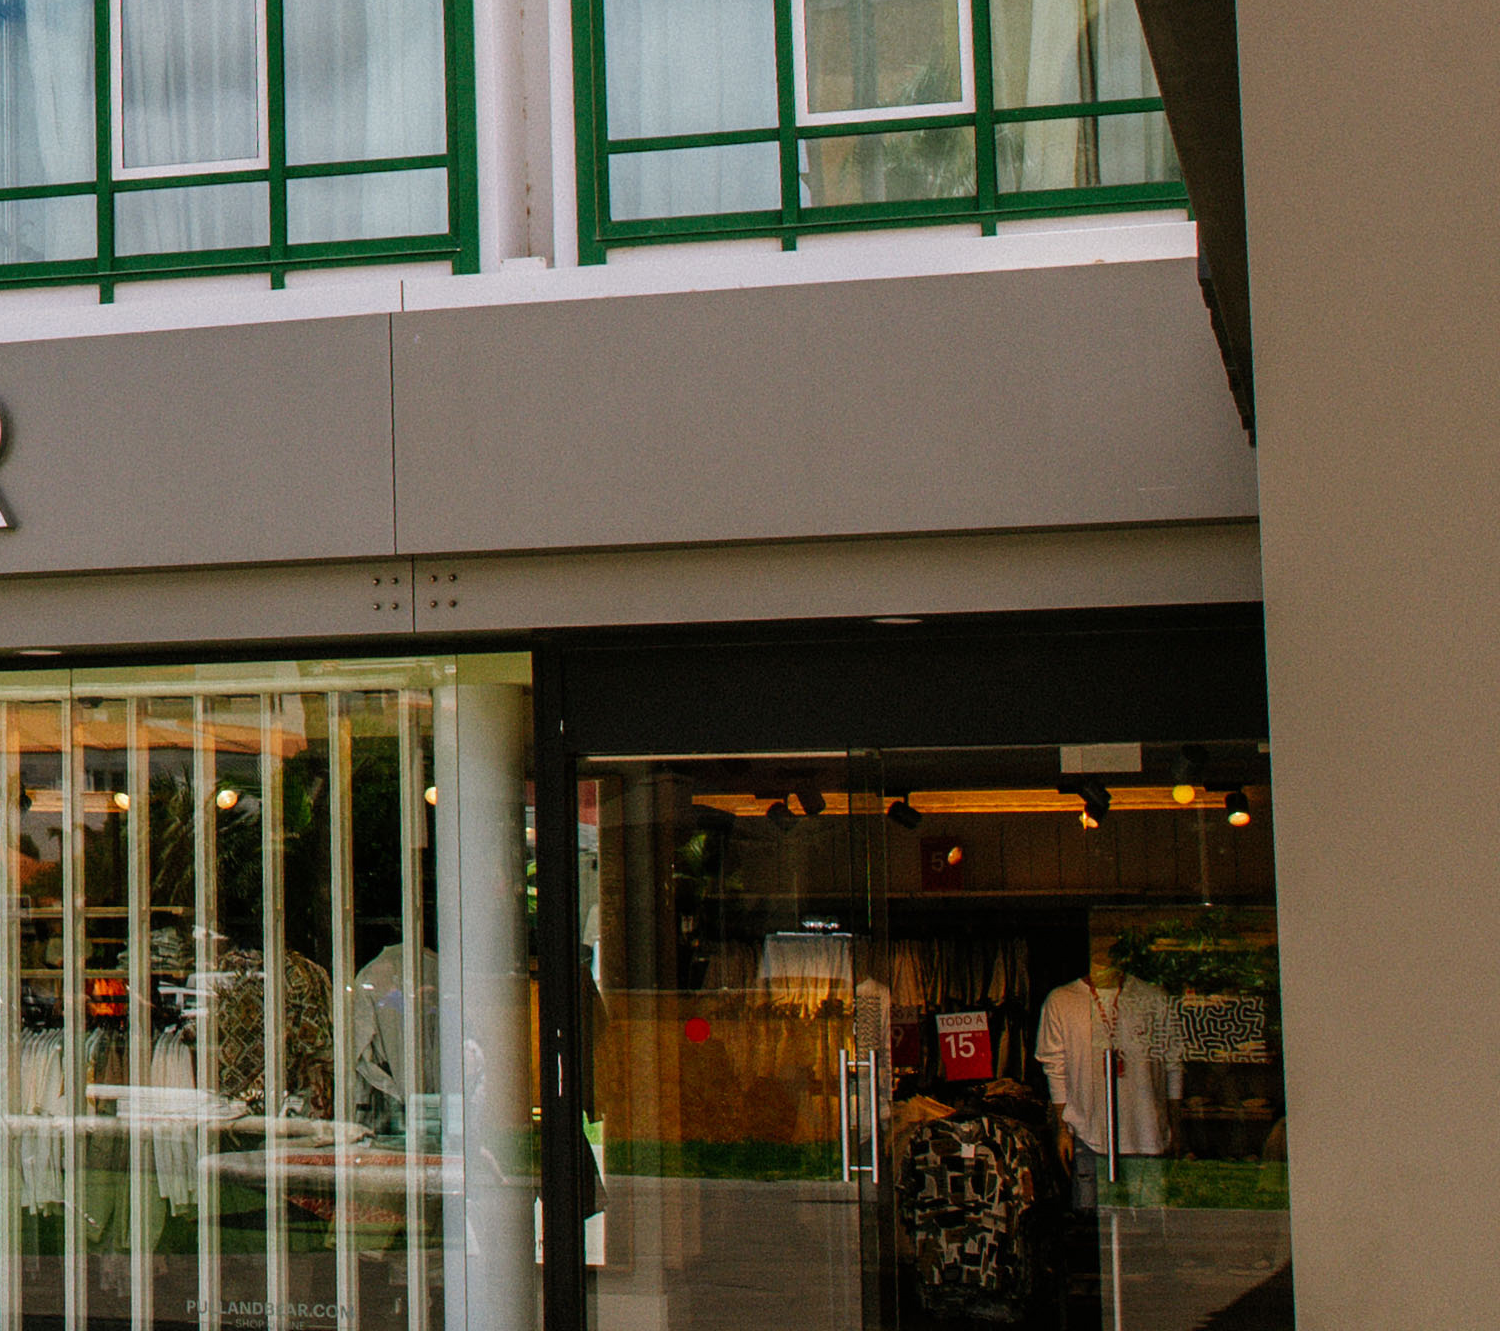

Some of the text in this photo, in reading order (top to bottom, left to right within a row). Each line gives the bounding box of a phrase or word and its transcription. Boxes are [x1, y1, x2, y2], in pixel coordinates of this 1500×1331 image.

[940, 1014, 984, 1027] TODO A
[945, 1033, 975, 1058] 15
